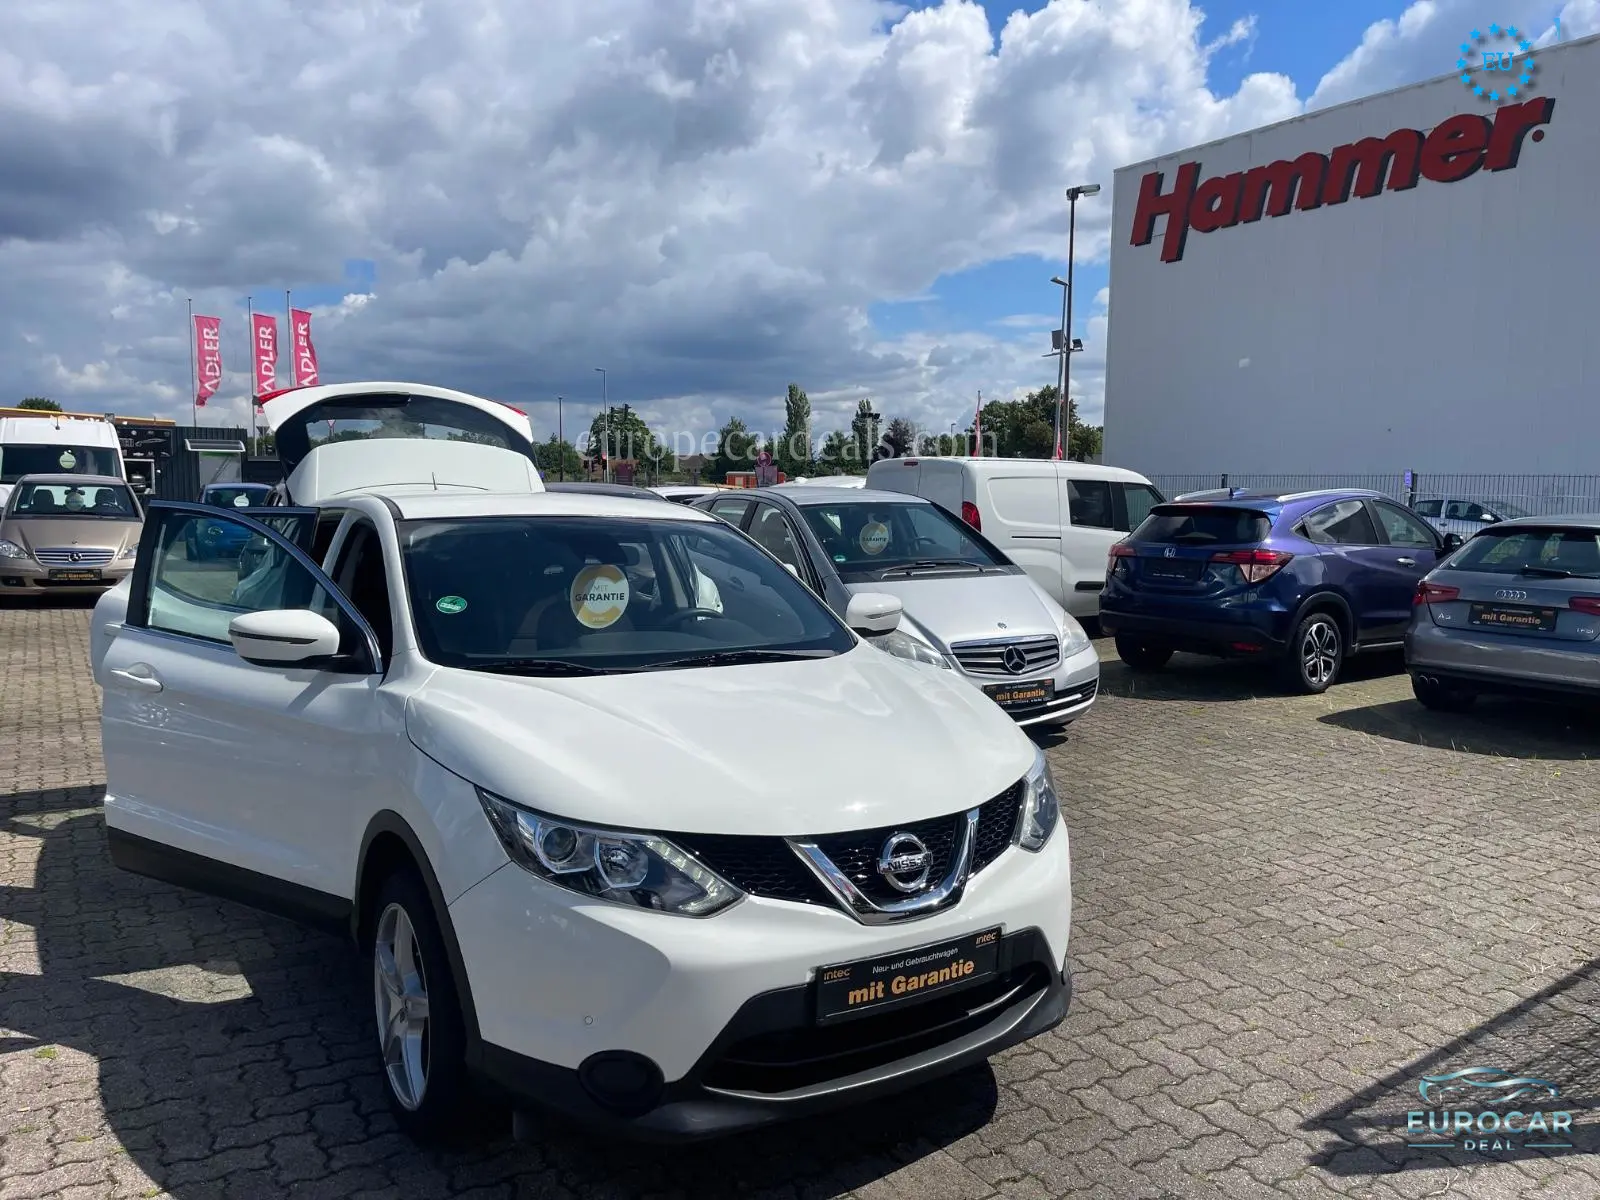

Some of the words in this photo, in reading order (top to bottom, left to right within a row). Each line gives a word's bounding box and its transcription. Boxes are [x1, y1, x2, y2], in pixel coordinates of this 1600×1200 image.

[203, 327, 221, 394] ADLER
[259, 326, 276, 392] ADLER
[575, 592, 625, 602] GARANTIE
[1481, 611, 1497, 621] mit
[1499, 613, 1542, 626] Garantie
[996, 692, 1010, 700] mit
[1012, 688, 1045, 699] Garantie
[975, 931, 997, 945] intec
[872, 964, 891, 974] Neu-
[891, 960, 905, 971] und
[905, 948, 958, 967] Gebrauchtwagen
[823, 967, 852, 981] intec
[848, 981, 884, 1005] mit
[891, 959, 974, 994] Garantie
